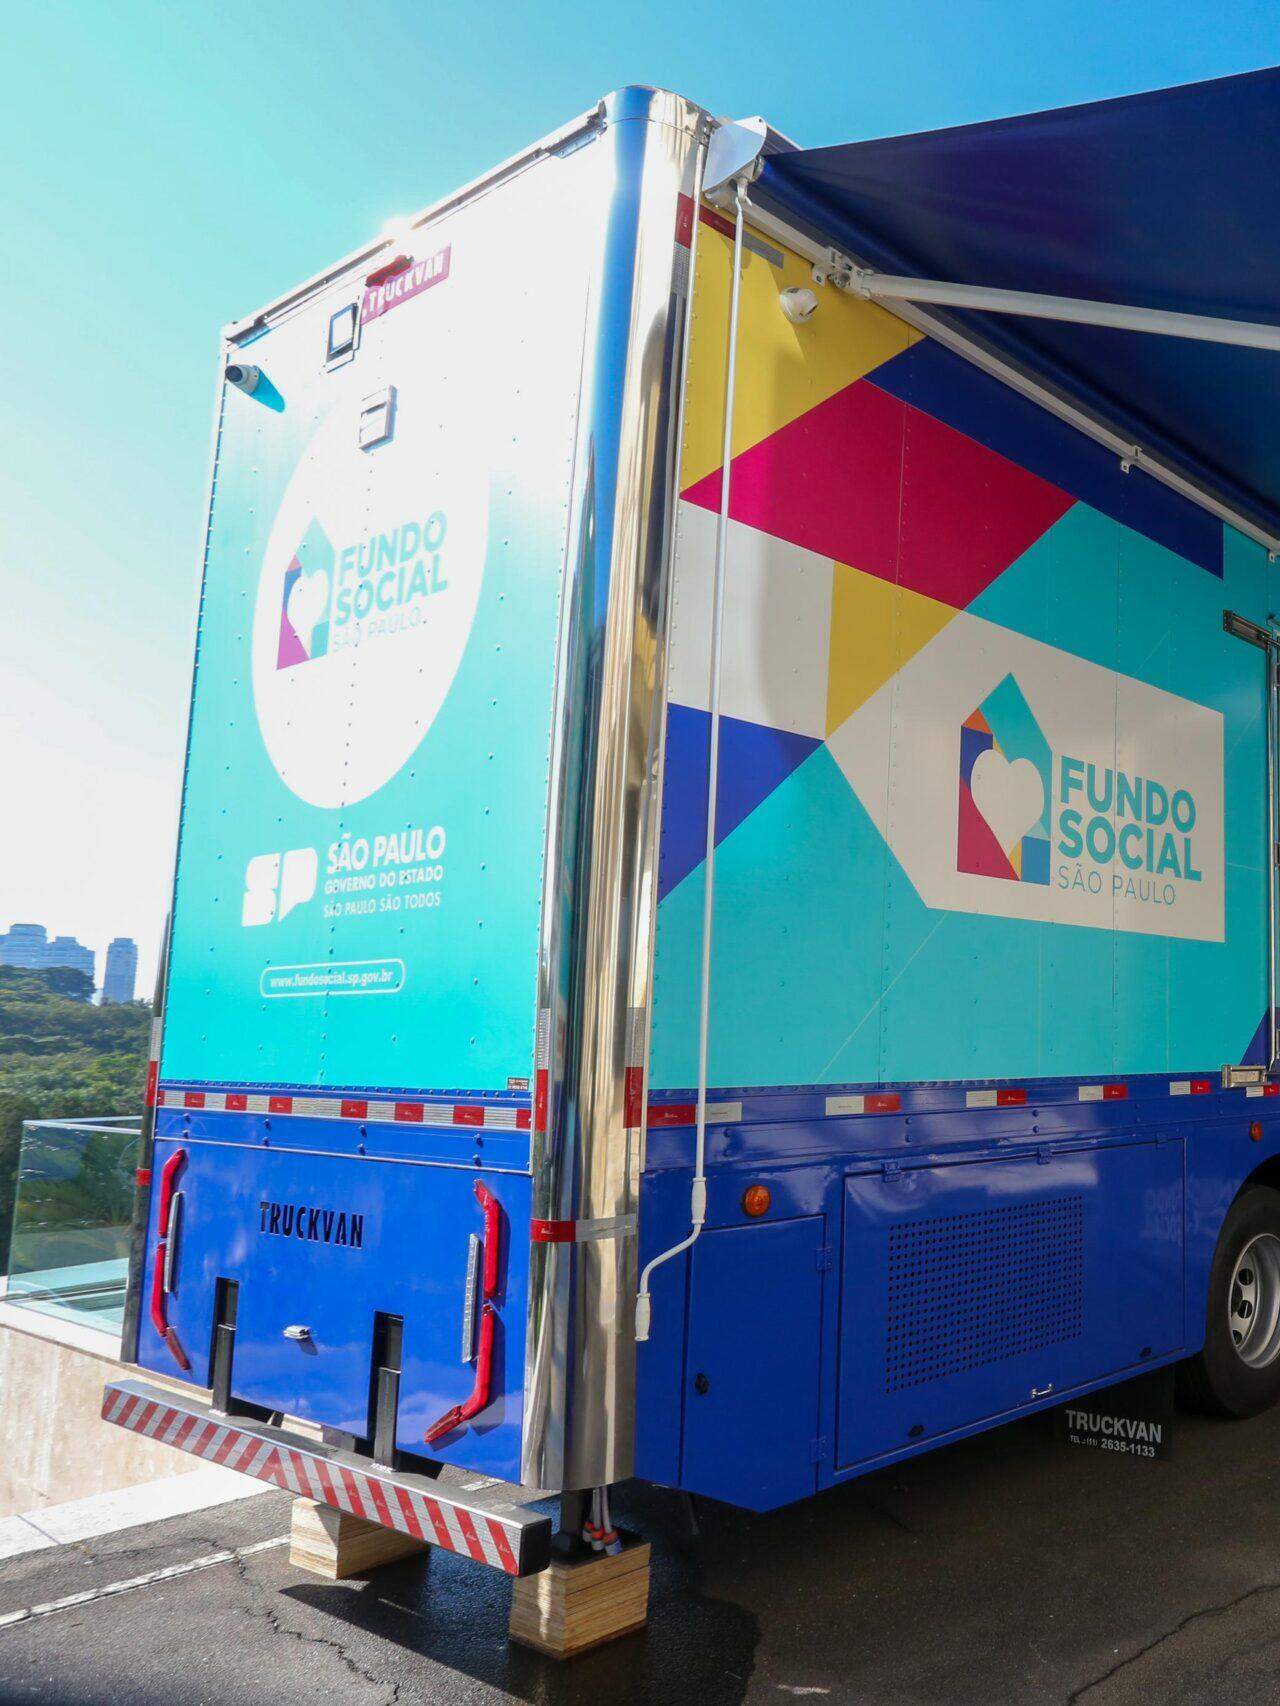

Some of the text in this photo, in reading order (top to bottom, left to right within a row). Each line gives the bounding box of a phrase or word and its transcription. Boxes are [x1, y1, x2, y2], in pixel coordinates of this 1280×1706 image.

[338, 510, 448, 586] FUNDO
[335, 554, 448, 626] SOCIAL
[1060, 755, 1196, 833] FUNDO
[327, 826, 446, 874] SÃO PAULO
[1058, 809, 1202, 882] SOCIAL
[324, 865, 444, 895] GOVERNO DO ESTADO
[1058, 863, 1176, 906] SÃO PAULO
[323, 891, 441, 918] SÃO PAULO SÃO TODOS
[270, 968, 394, 987] www.fundosocial.sp.gov.br
[260, 1201, 364, 1249] TRUCKVAN
[1065, 1409, 1162, 1443] TRUCKVAN
[1101, 1438, 1155, 1458] 2635-1133
